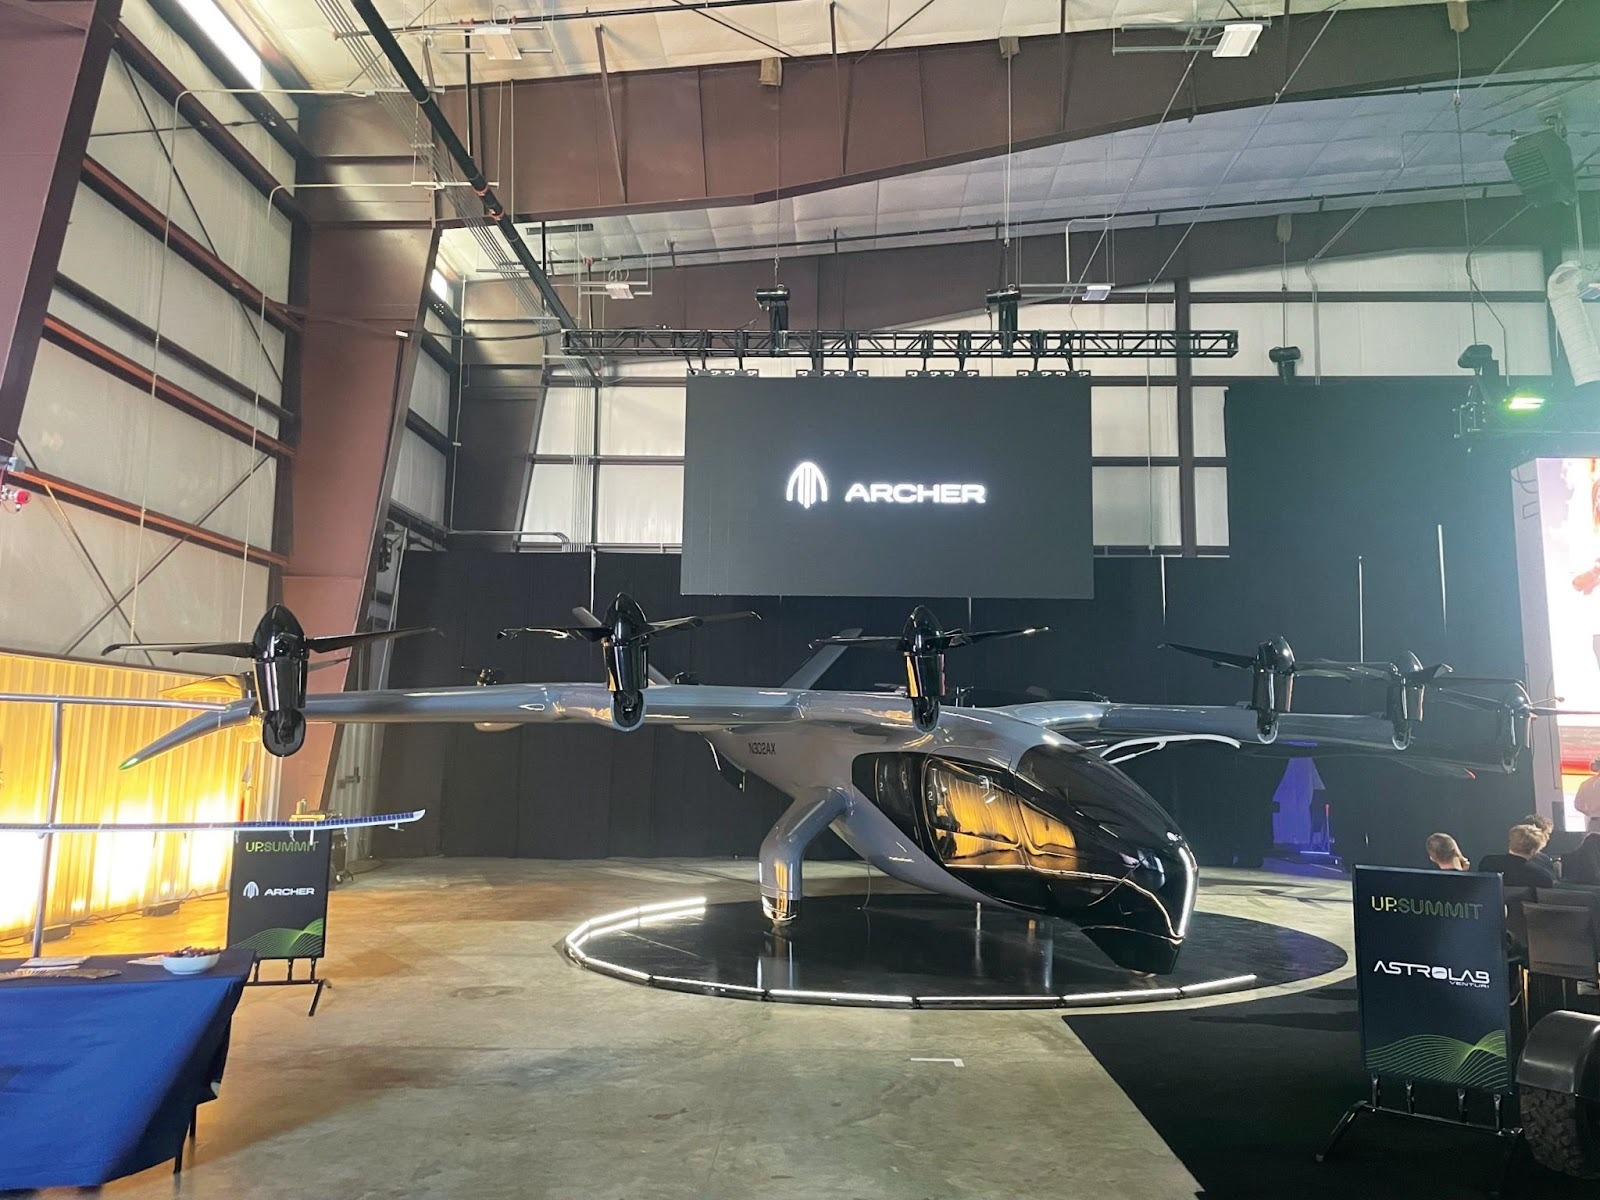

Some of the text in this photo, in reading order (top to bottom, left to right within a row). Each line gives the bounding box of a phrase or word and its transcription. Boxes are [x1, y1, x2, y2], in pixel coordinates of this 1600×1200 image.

[844, 483, 987, 504] ARCHER
[264, 887, 315, 896] ARCHER
[1373, 960, 1490, 984] ASTROLAB
[1449, 980, 1490, 989] VENTURI
